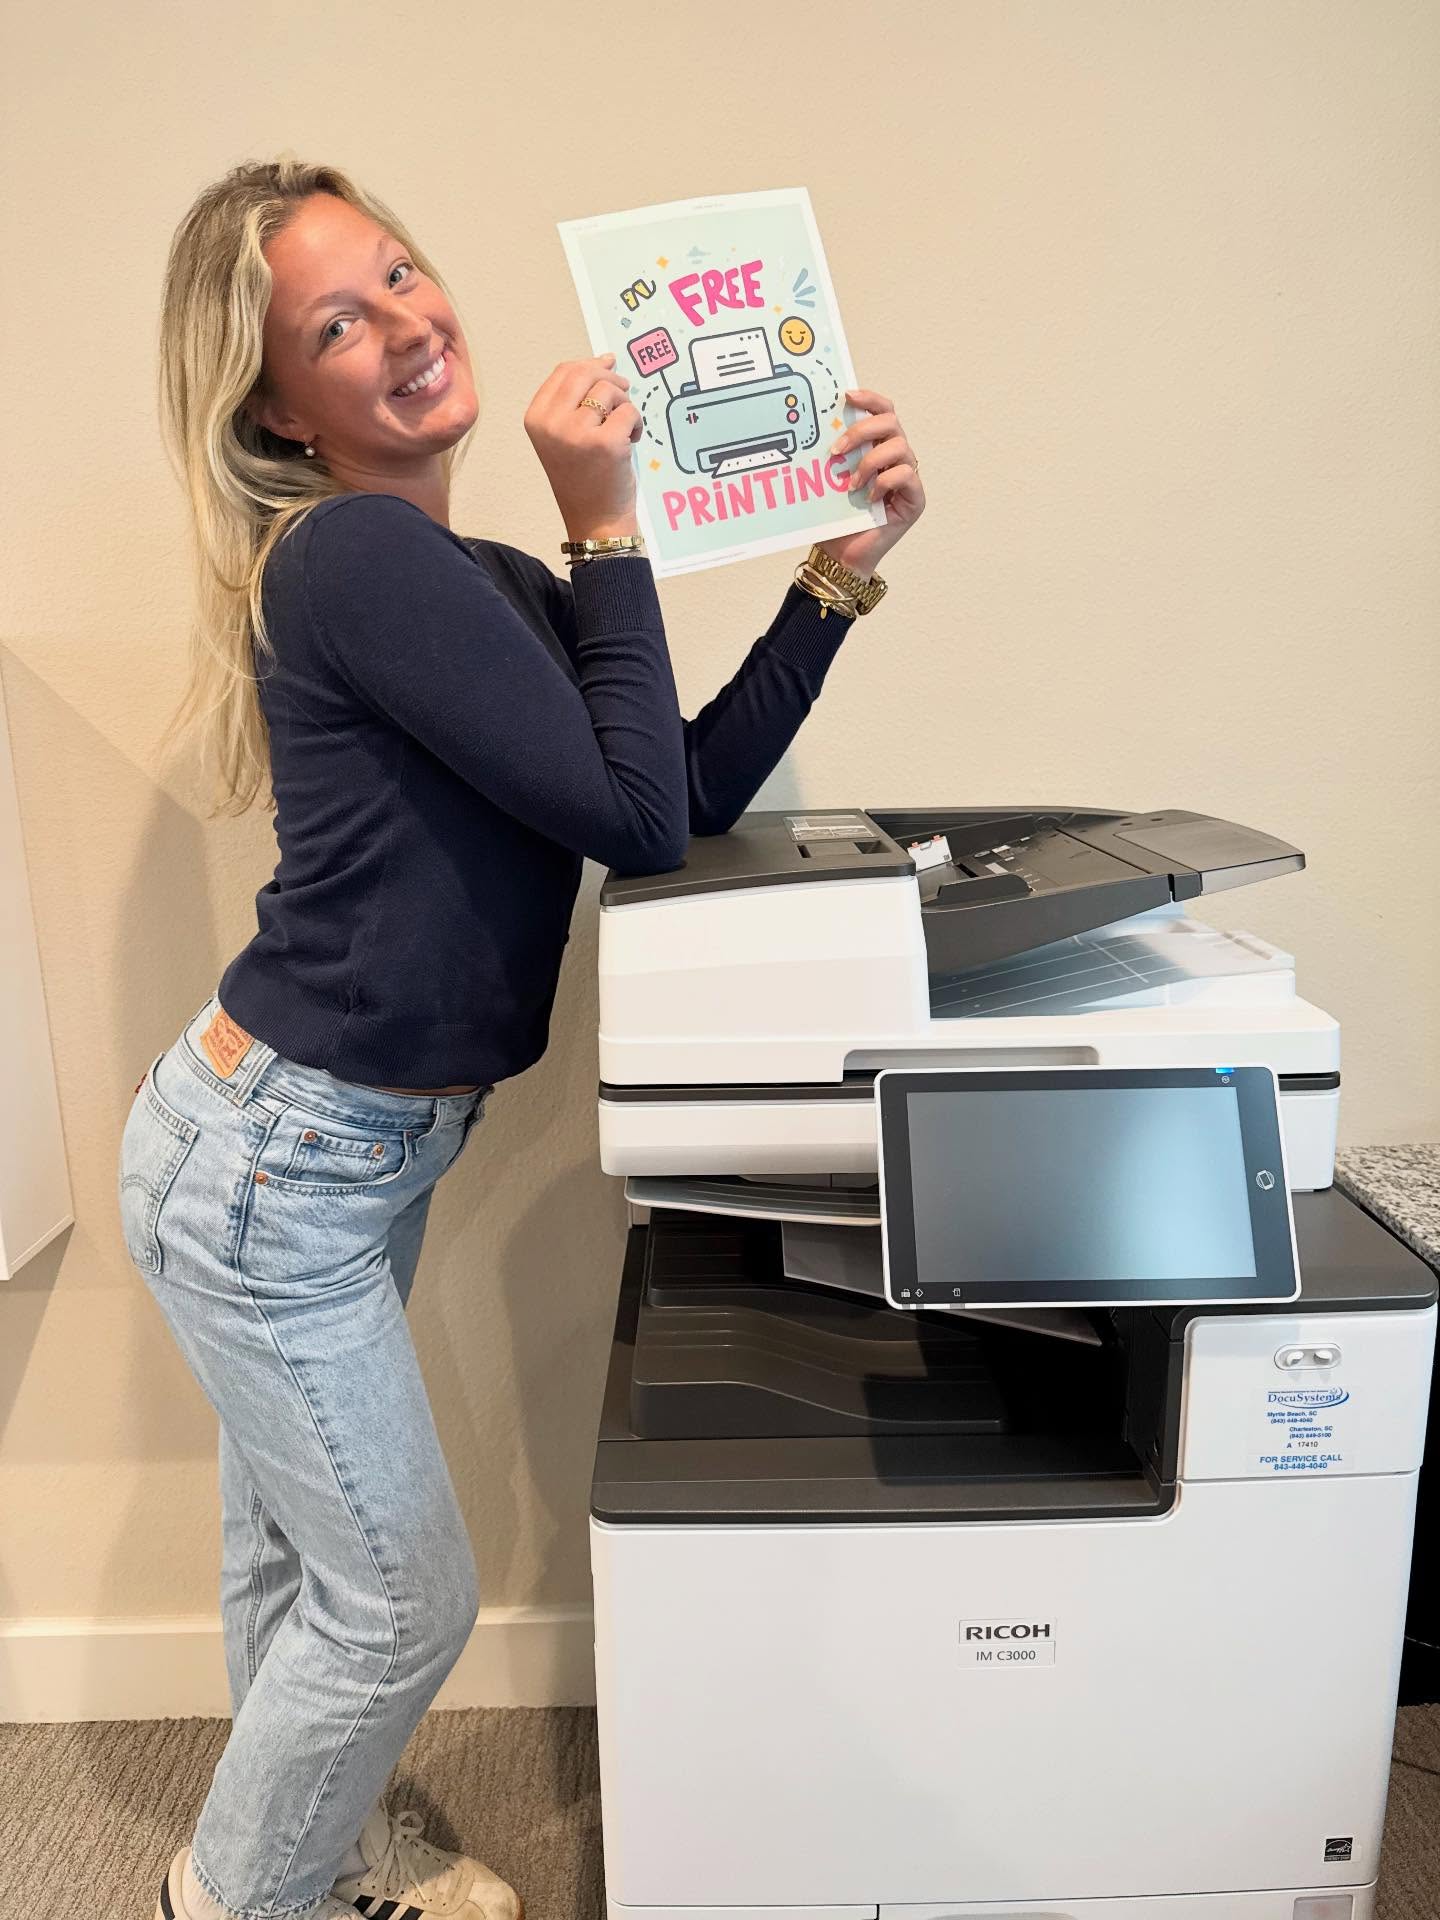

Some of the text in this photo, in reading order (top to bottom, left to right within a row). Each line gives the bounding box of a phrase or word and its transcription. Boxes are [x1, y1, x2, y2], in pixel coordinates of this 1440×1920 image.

[668, 260, 765, 326] FREE
[638, 339, 671, 365] FREE
[1267, 1392, 1341, 1403] DocuSystems
[1274, 1462, 1328, 1470] 843-448-4040
[966, 1623, 1050, 1640] RICOH
[976, 1650, 1036, 1661] IM C3000
